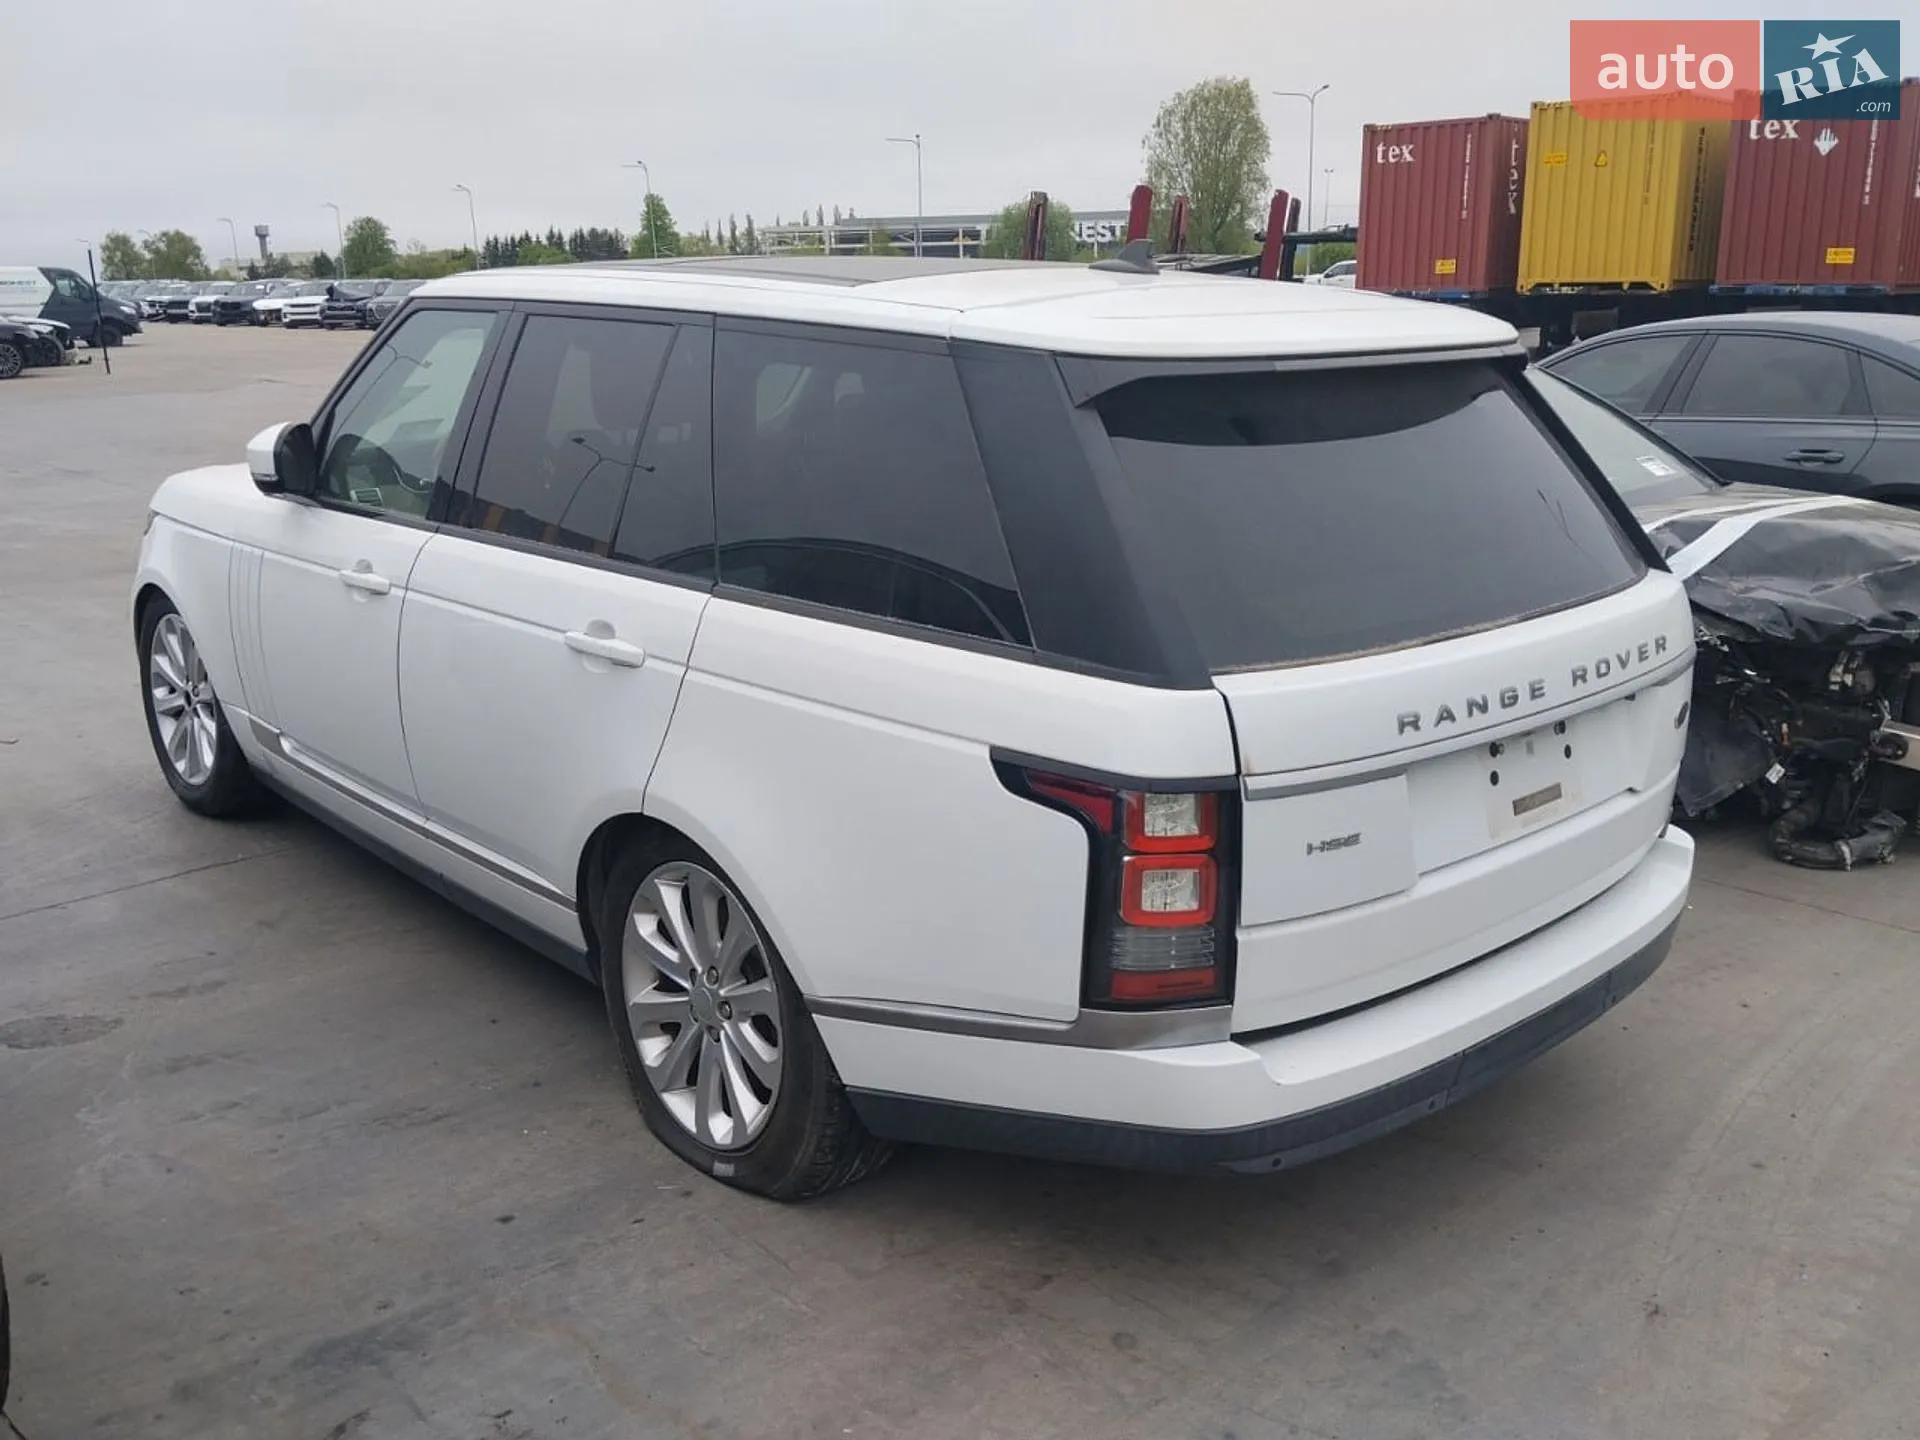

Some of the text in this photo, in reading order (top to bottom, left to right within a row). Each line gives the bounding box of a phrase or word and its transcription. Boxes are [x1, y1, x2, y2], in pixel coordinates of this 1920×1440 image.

[1749, 115, 1801, 140] tex
[1376, 142, 1415, 164] tex
[1396, 634, 1668, 735] RANGE ROVER
[1306, 832, 1362, 856] HSE
